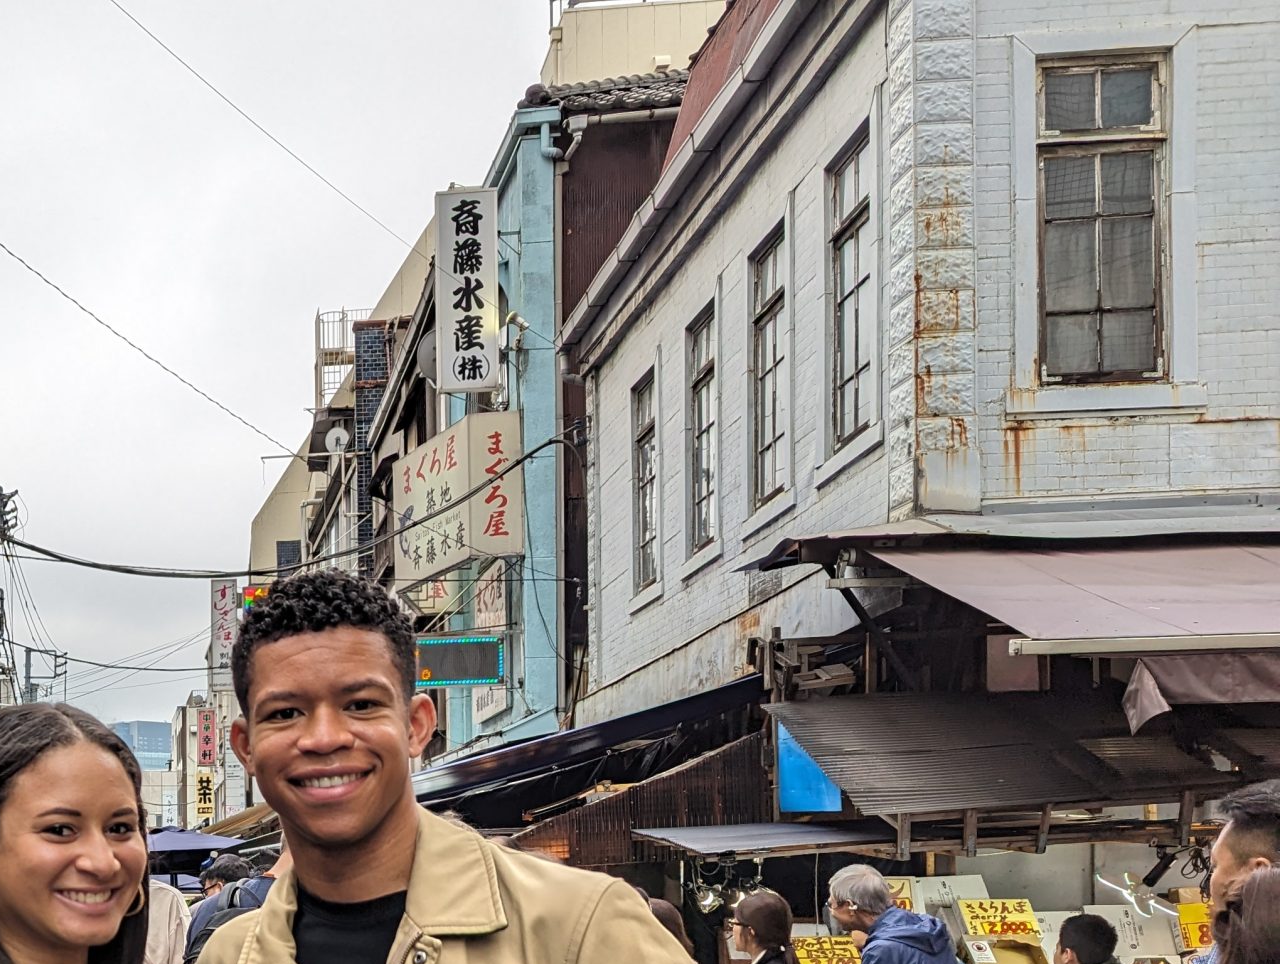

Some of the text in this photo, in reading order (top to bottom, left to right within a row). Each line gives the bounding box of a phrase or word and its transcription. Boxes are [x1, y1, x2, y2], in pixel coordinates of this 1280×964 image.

[483, 431, 510, 537] まぐろ屋
[965, 901, 1028, 914] さくらんぼ
